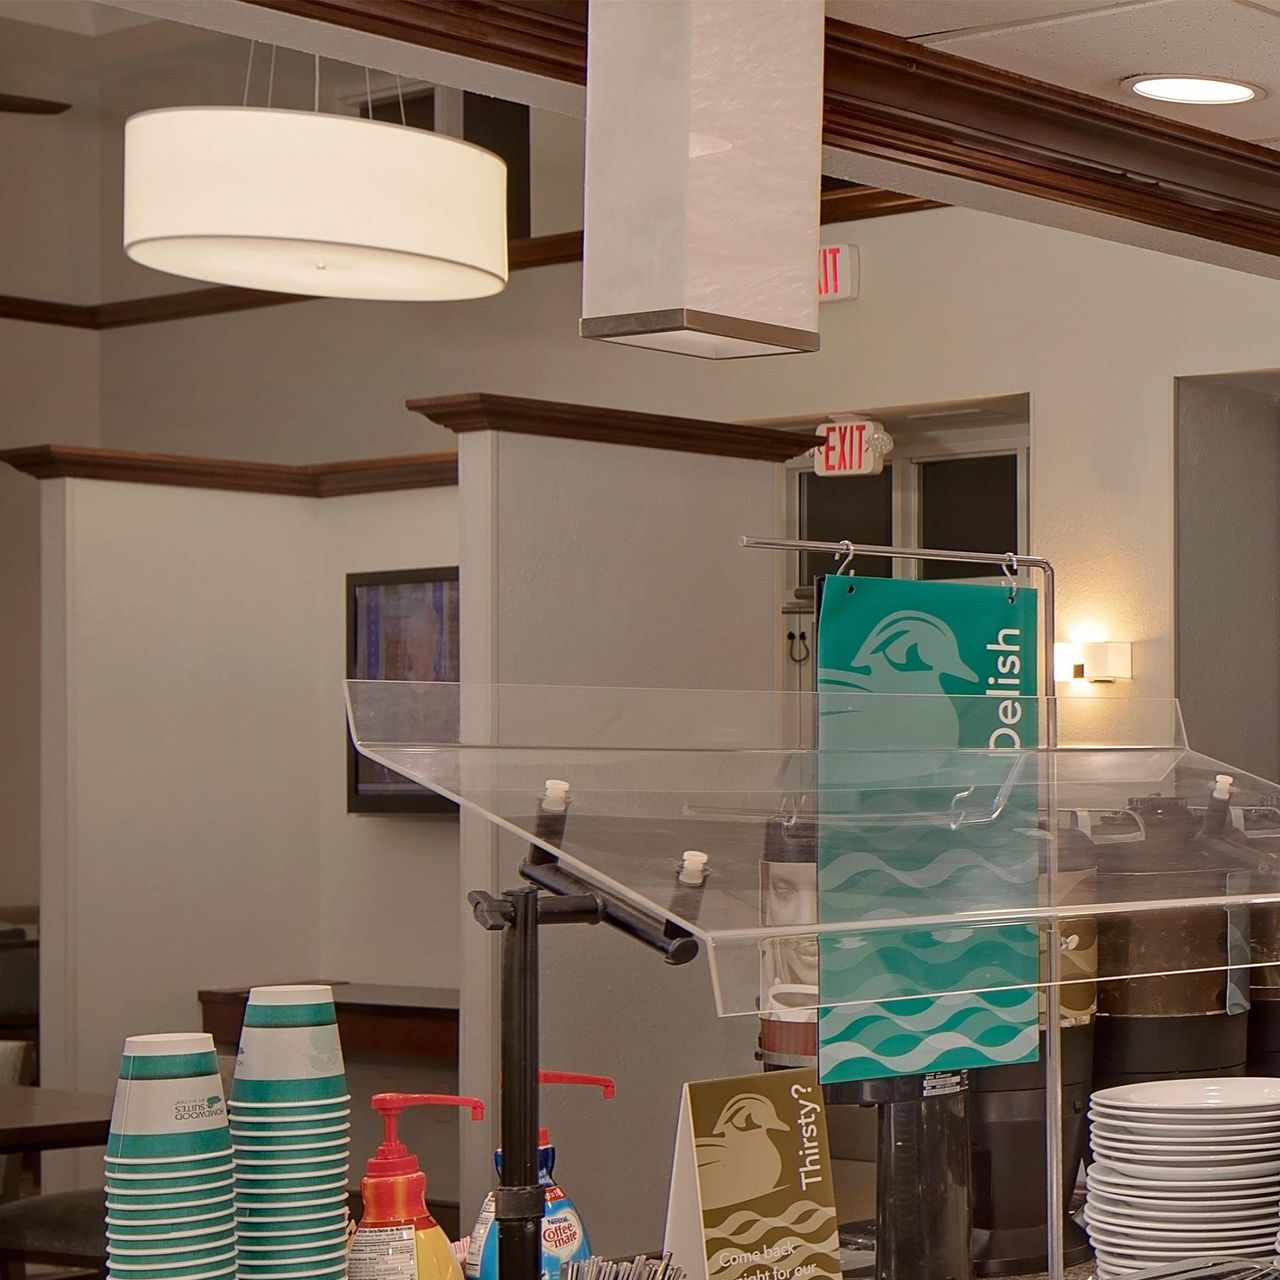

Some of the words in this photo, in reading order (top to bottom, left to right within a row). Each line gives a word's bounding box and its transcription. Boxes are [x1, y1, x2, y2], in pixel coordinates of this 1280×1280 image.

[818, 247, 840, 295] IT
[825, 424, 866, 471] EXIT
[986, 628, 1022, 757] Delish
[174, 1103, 205, 1113] SUITES
[790, 1083, 823, 1191] Thirsty?
[554, 1232, 578, 1250] mate
[719, 1250, 760, 1268] Come
[763, 1240, 795, 1259] back
[772, 1265, 792, 1280] for
[794, 1263, 817, 1277] our
